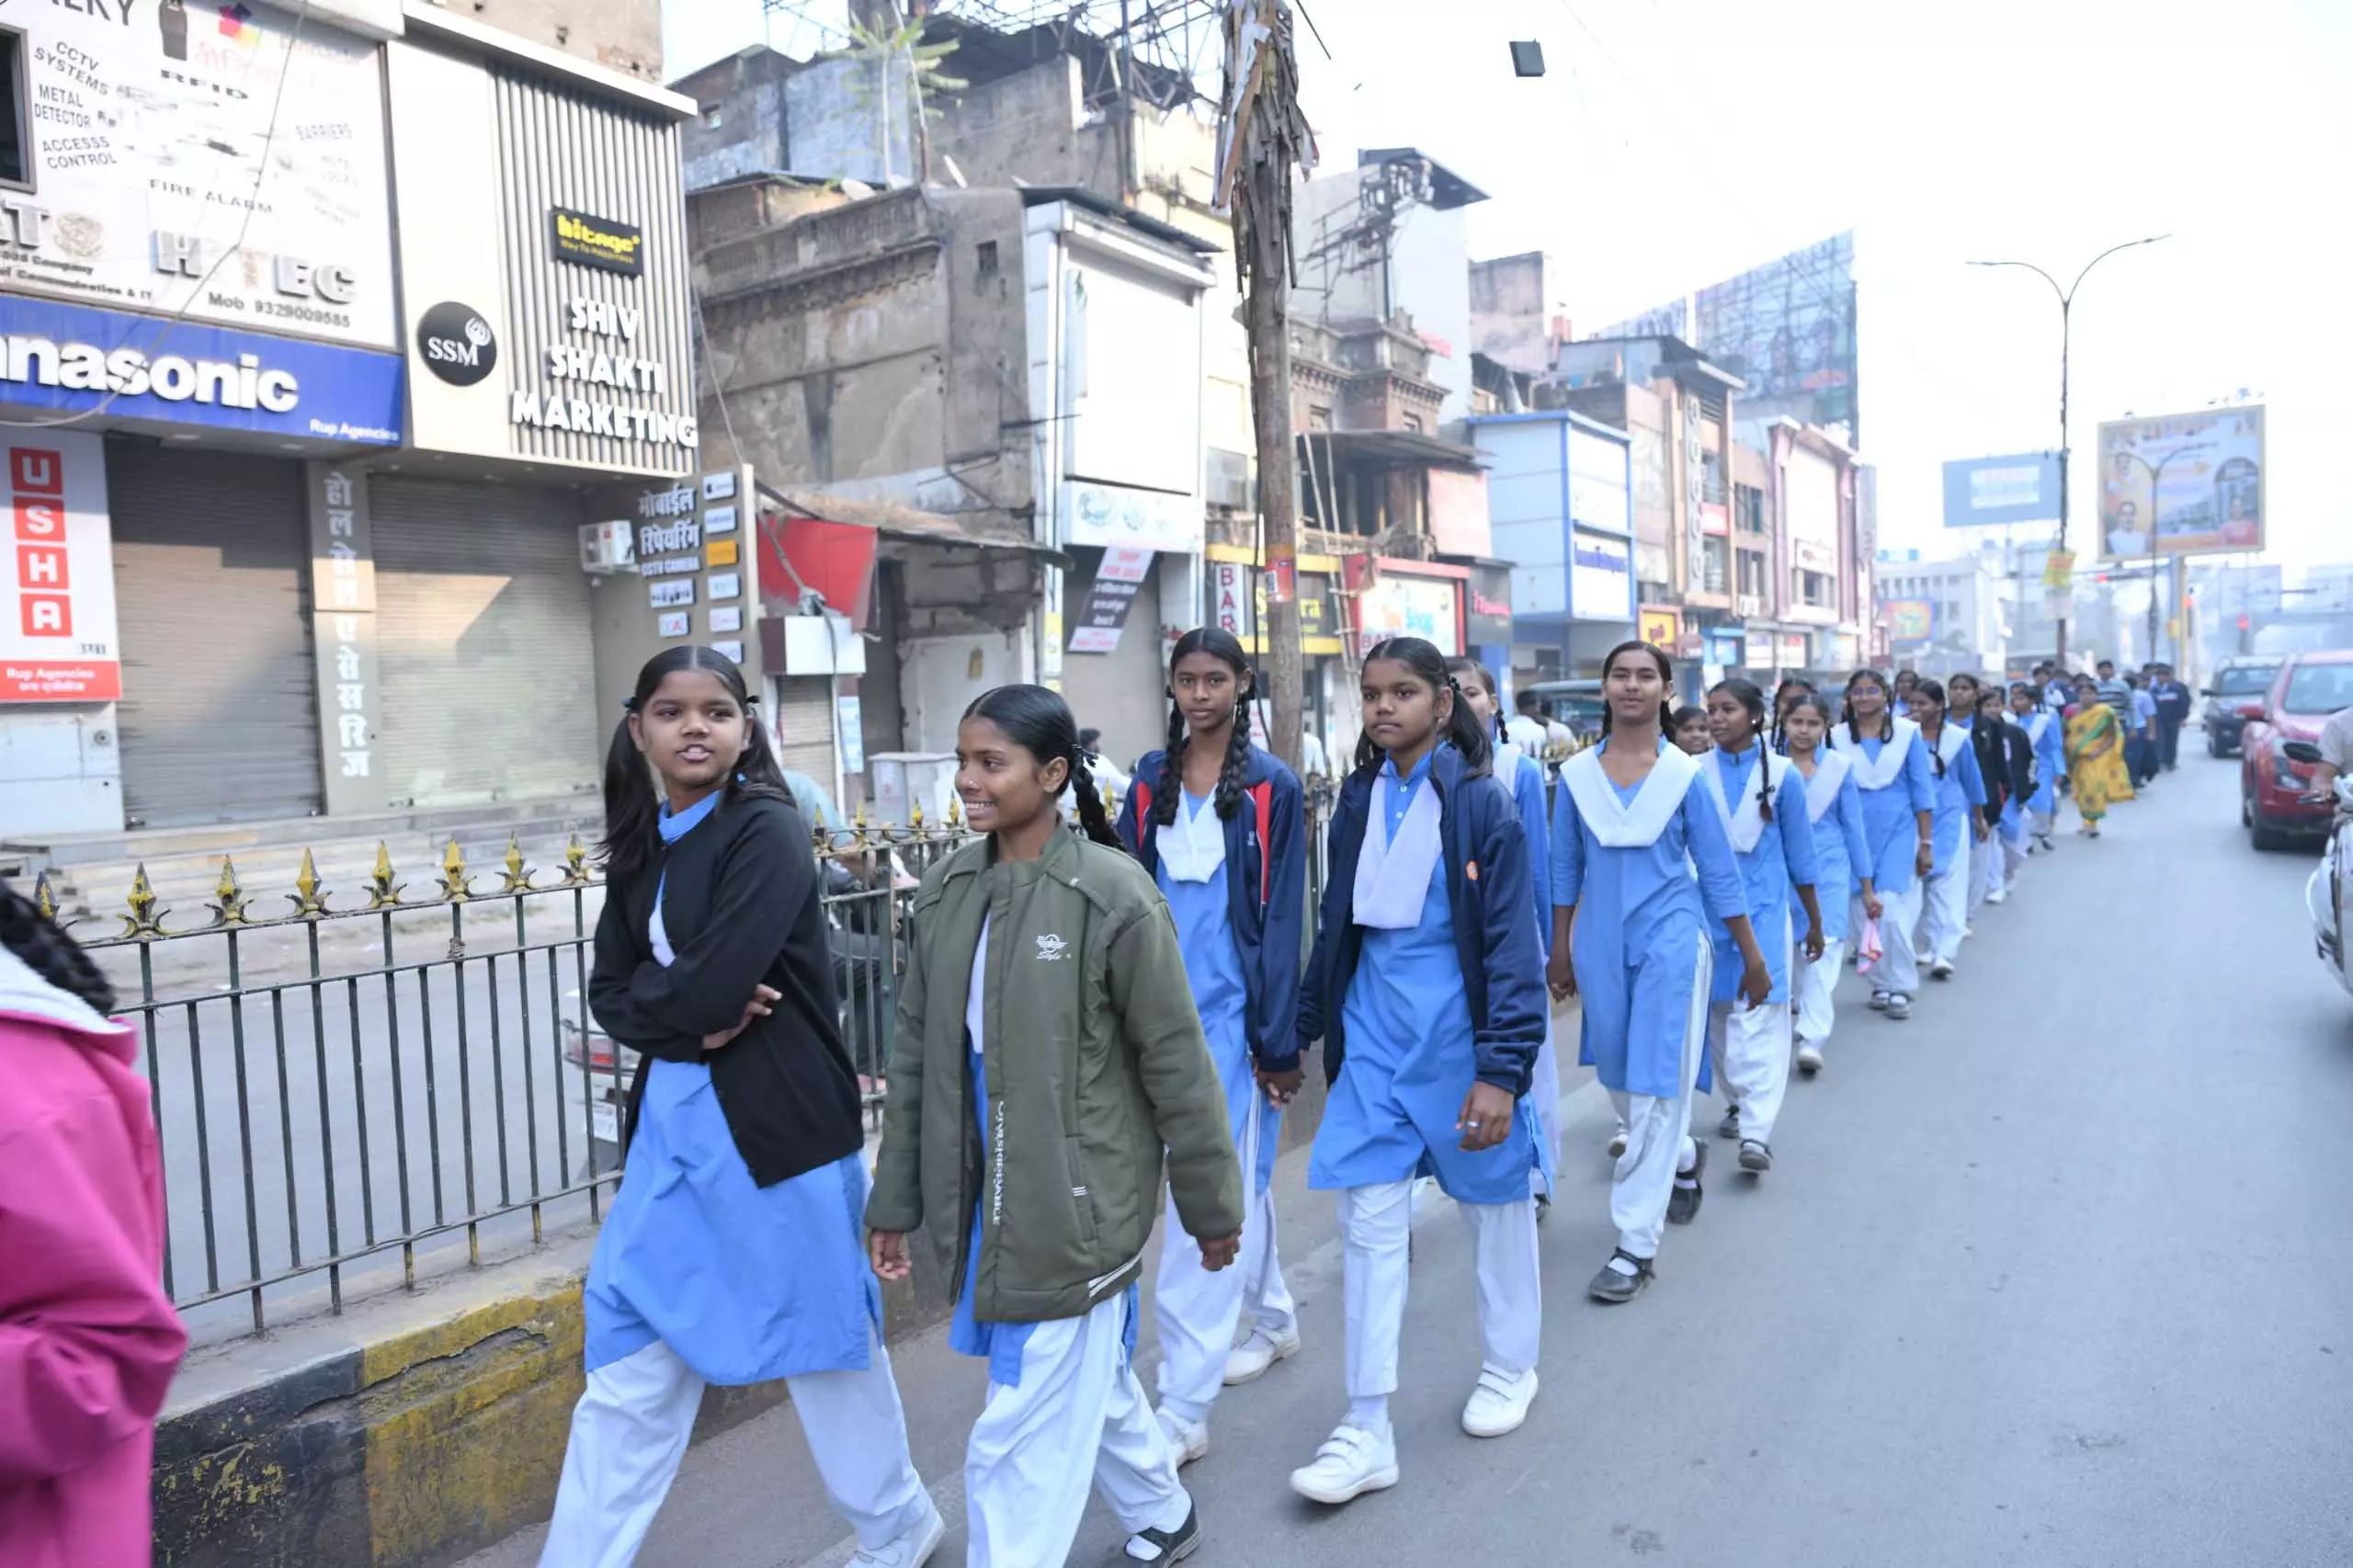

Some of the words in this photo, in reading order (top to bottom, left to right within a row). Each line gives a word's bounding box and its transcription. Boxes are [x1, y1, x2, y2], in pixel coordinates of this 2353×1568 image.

[34, 47, 109, 96] SYSTEMS
[56, 41, 99, 71] CCTV
[34, 103, 91, 128] DETECTOR
[39, 85, 84, 108] METAL
[47, 152, 117, 169] CONTROL
[149, 178, 196, 197] FIRE
[206, 189, 272, 214] ALARM
[208, 292, 245, 311] Mob
[569, 297, 640, 340] SHIV
[427, 336, 479, 366] SSM
[551, 345, 663, 393] SHAKTI
[0, 333, 299, 413] nasonic
[512, 390, 699, 449] MARKETING
[22, 455, 63, 631] USHA
[1221, 566, 1236, 633] BAR
